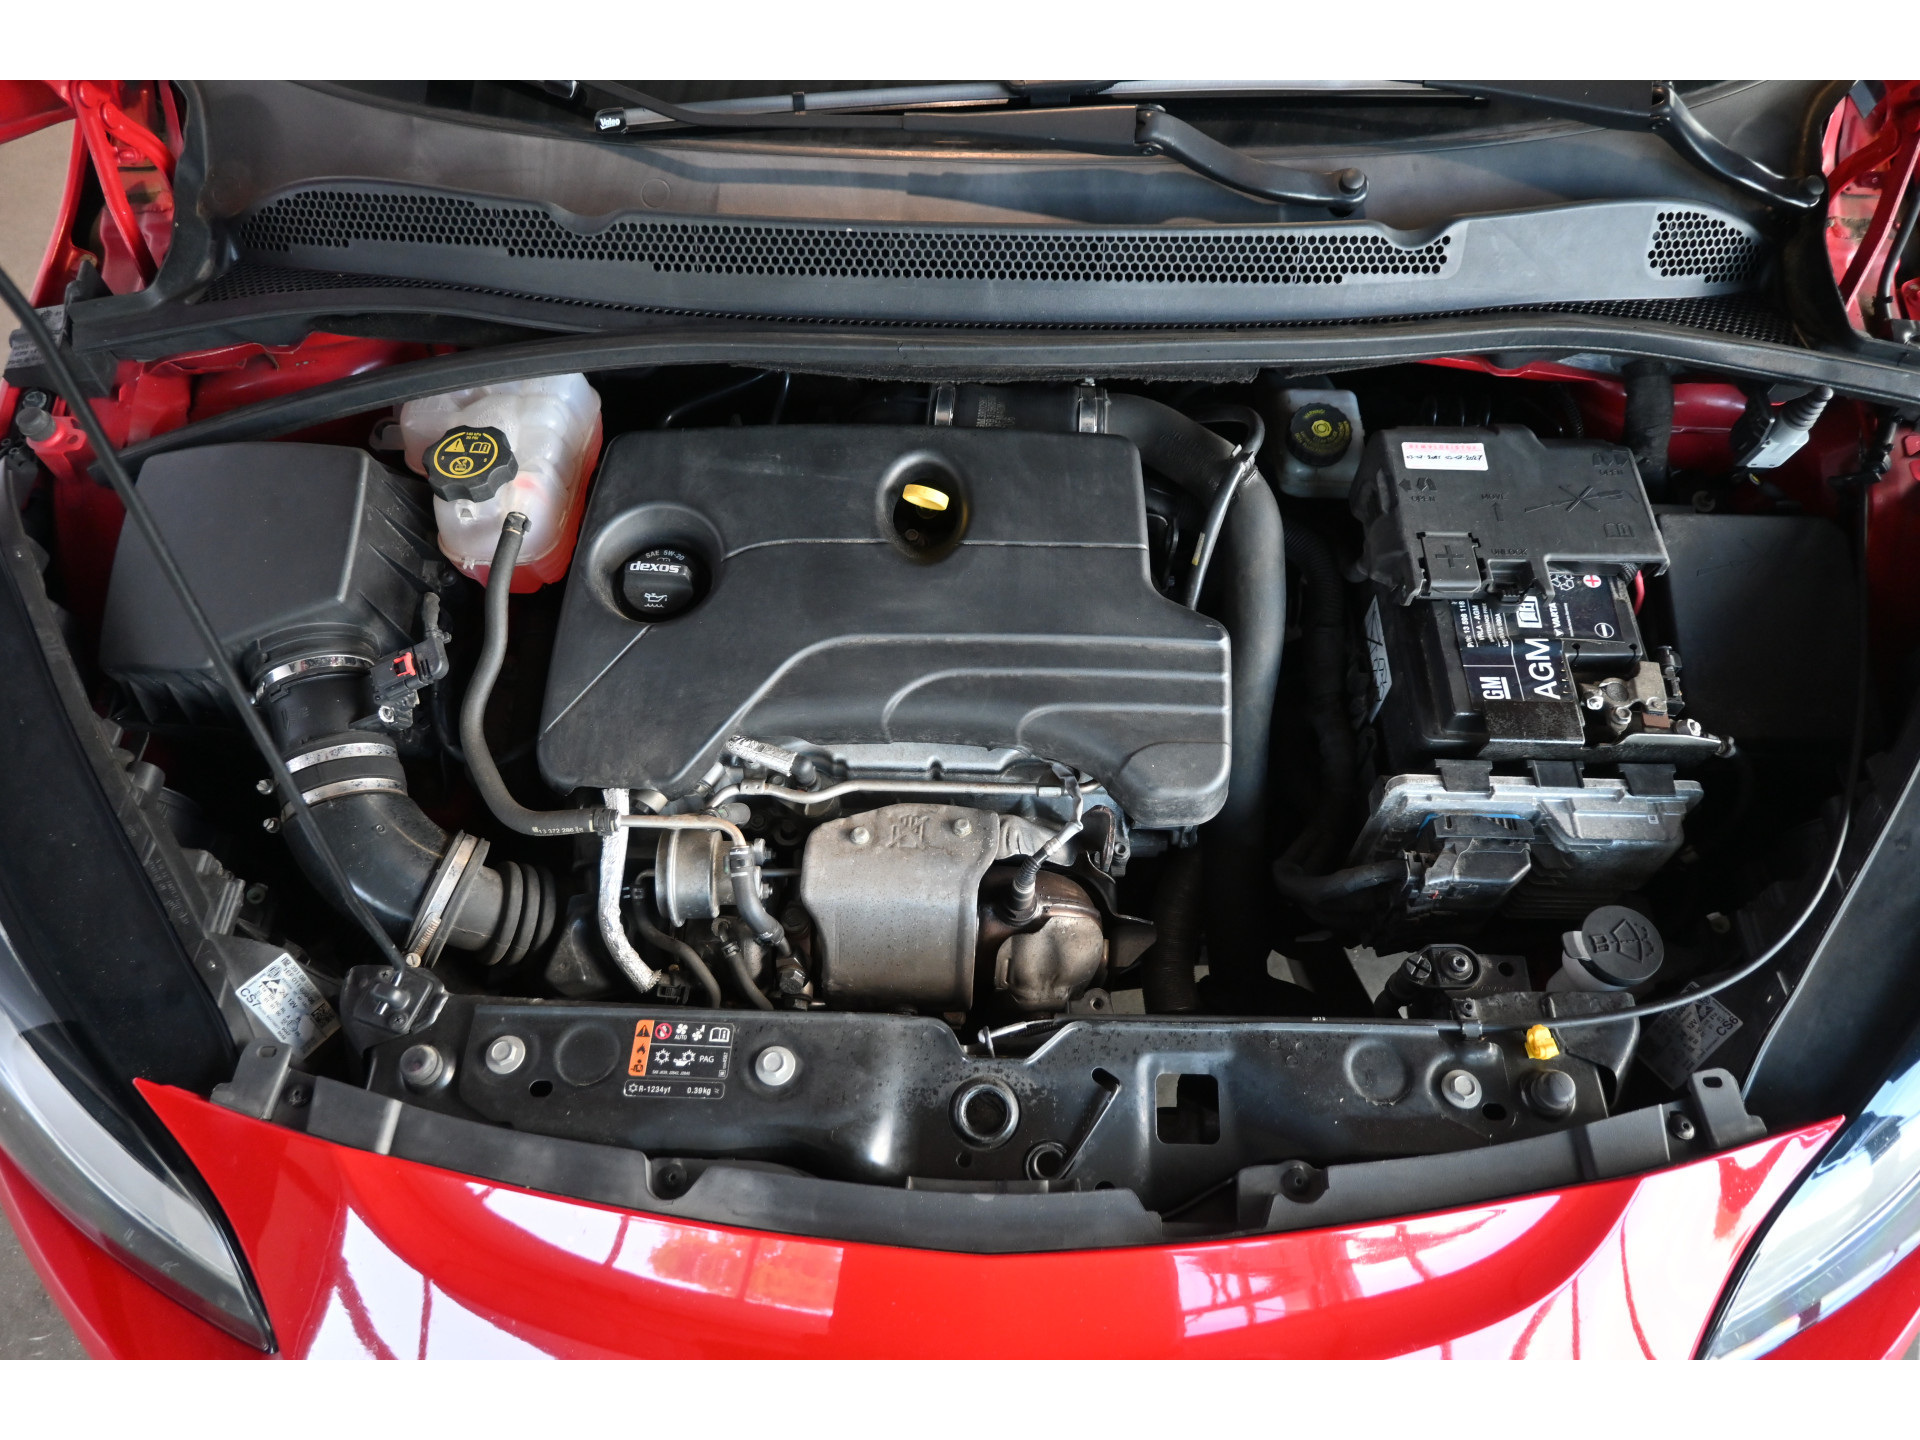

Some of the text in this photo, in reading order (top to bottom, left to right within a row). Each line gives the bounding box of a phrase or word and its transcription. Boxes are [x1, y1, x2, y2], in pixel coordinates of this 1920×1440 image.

[600, 118, 620, 127] Valeo
[645, 550, 695, 560] SAE 5W-20
[629, 561, 682, 573] dexos
[1549, 602, 1561, 628] VARTA
[1524, 638, 1561, 699] AGM
[1480, 677, 1507, 699] GM
[240, 987, 261, 1008] CS7
[287, 997, 298, 1009] 12V
[1686, 1018, 1698, 1030] 12V
[1716, 1016, 1738, 1036] CS6
[699, 1055, 714, 1063] PAG
[638, 1085, 671, 1094] R-1234yf
